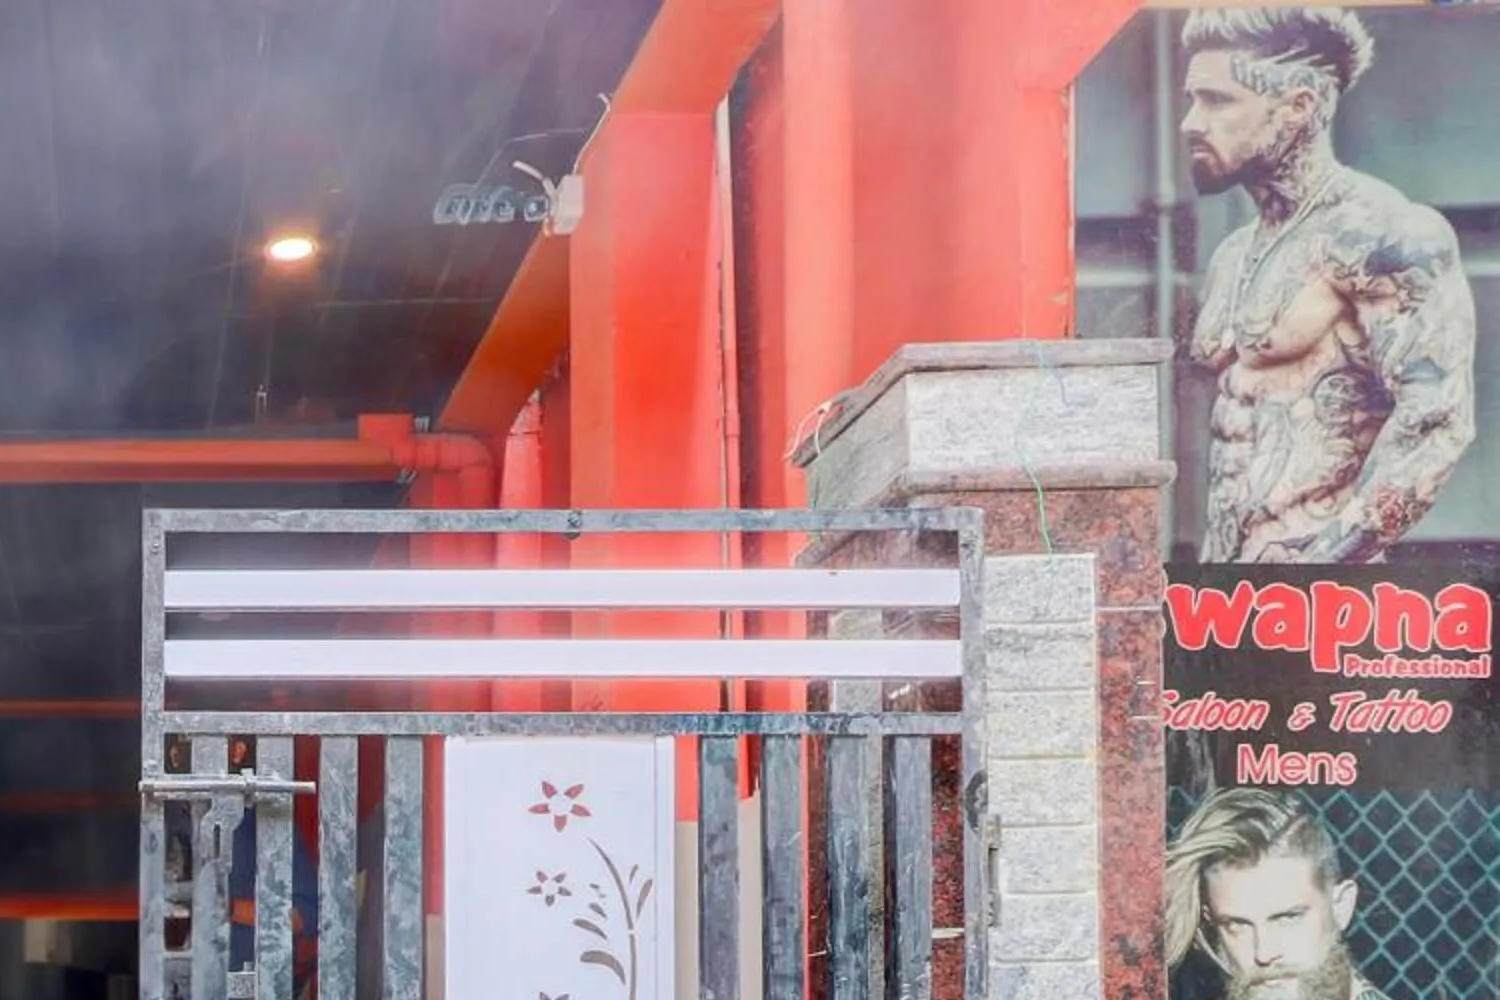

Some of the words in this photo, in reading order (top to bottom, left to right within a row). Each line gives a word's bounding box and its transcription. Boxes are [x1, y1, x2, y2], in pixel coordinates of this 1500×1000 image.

[1162, 579, 1492, 672] wapna
[1343, 654, 1492, 678] Professional
[1288, 702, 1316, 731] &
[1329, 689, 1452, 732] Tattoo
[1237, 744, 1357, 785] Mens
